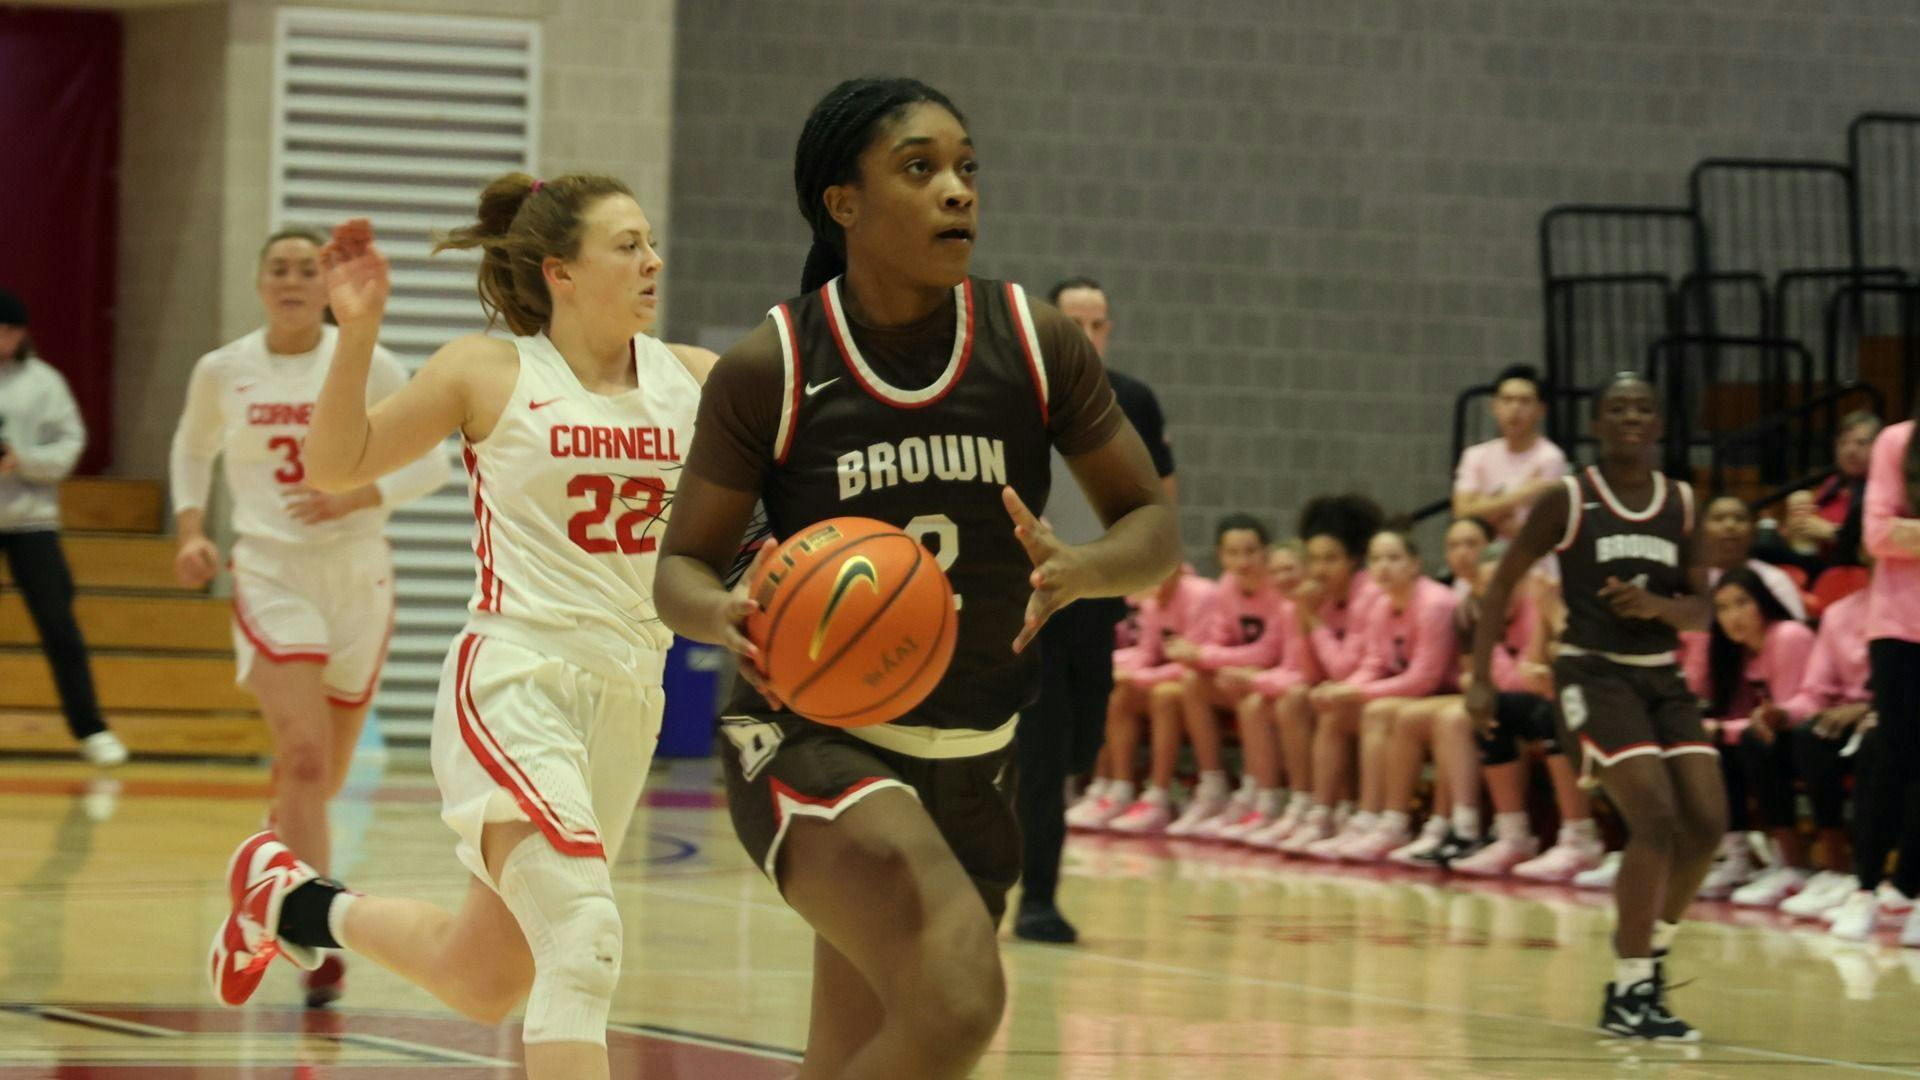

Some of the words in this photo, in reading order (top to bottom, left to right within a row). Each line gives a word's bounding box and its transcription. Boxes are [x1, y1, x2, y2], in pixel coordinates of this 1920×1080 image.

[247, 402, 313, 426] CORNE
[267, 435, 306, 485] 3
[550, 425, 681, 461] CORNELL
[837, 434, 1008, 501] BROWN
[567, 474, 666, 554] 22
